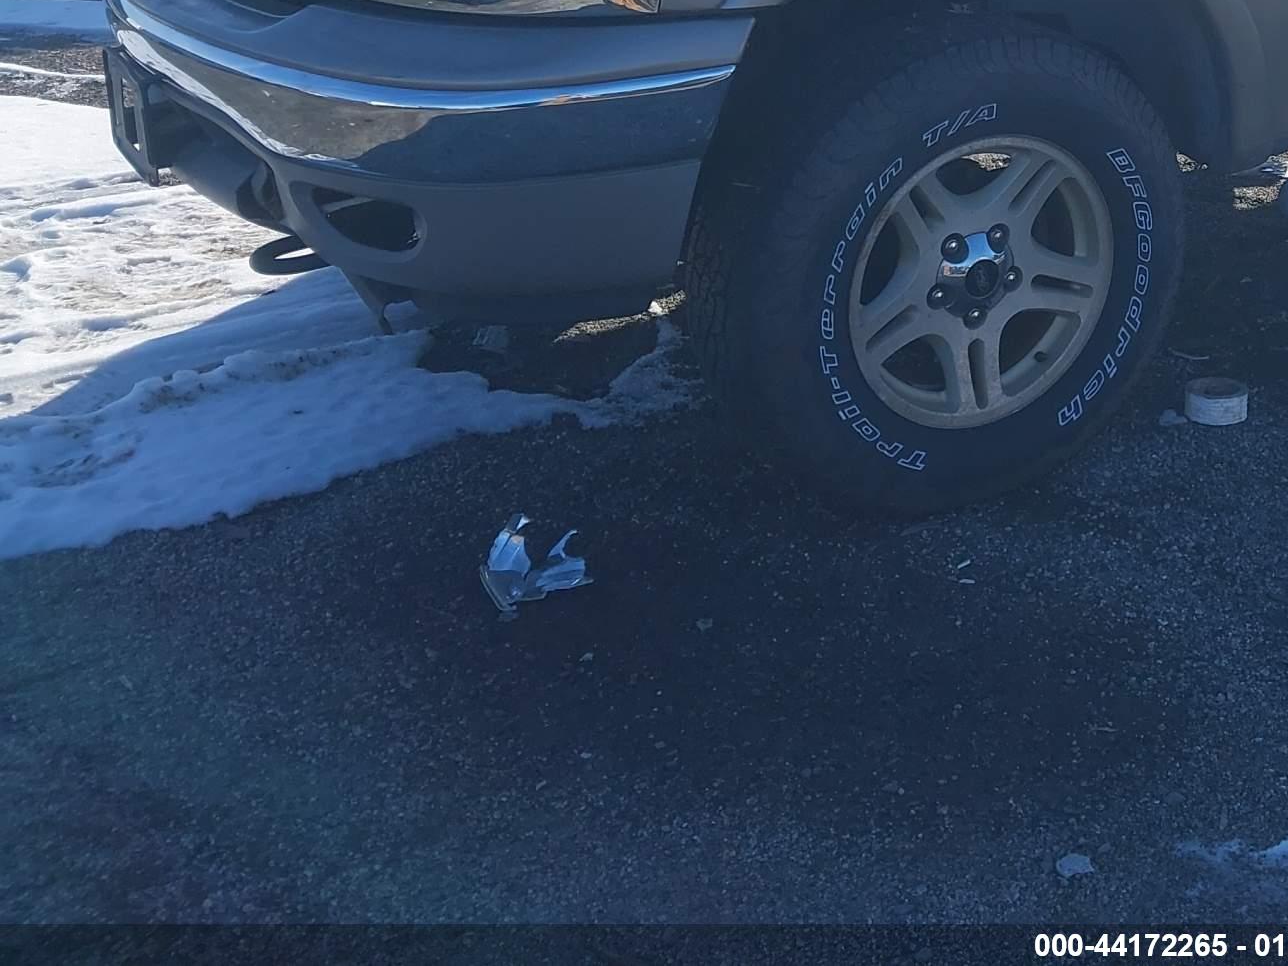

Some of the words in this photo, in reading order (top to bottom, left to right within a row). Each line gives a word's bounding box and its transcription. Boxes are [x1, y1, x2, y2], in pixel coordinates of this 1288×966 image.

[819, 157, 926, 471] Trail-Terrain
[922, 103, 998, 147] T/A
[1057, 147, 1153, 427] BFGoodrich
